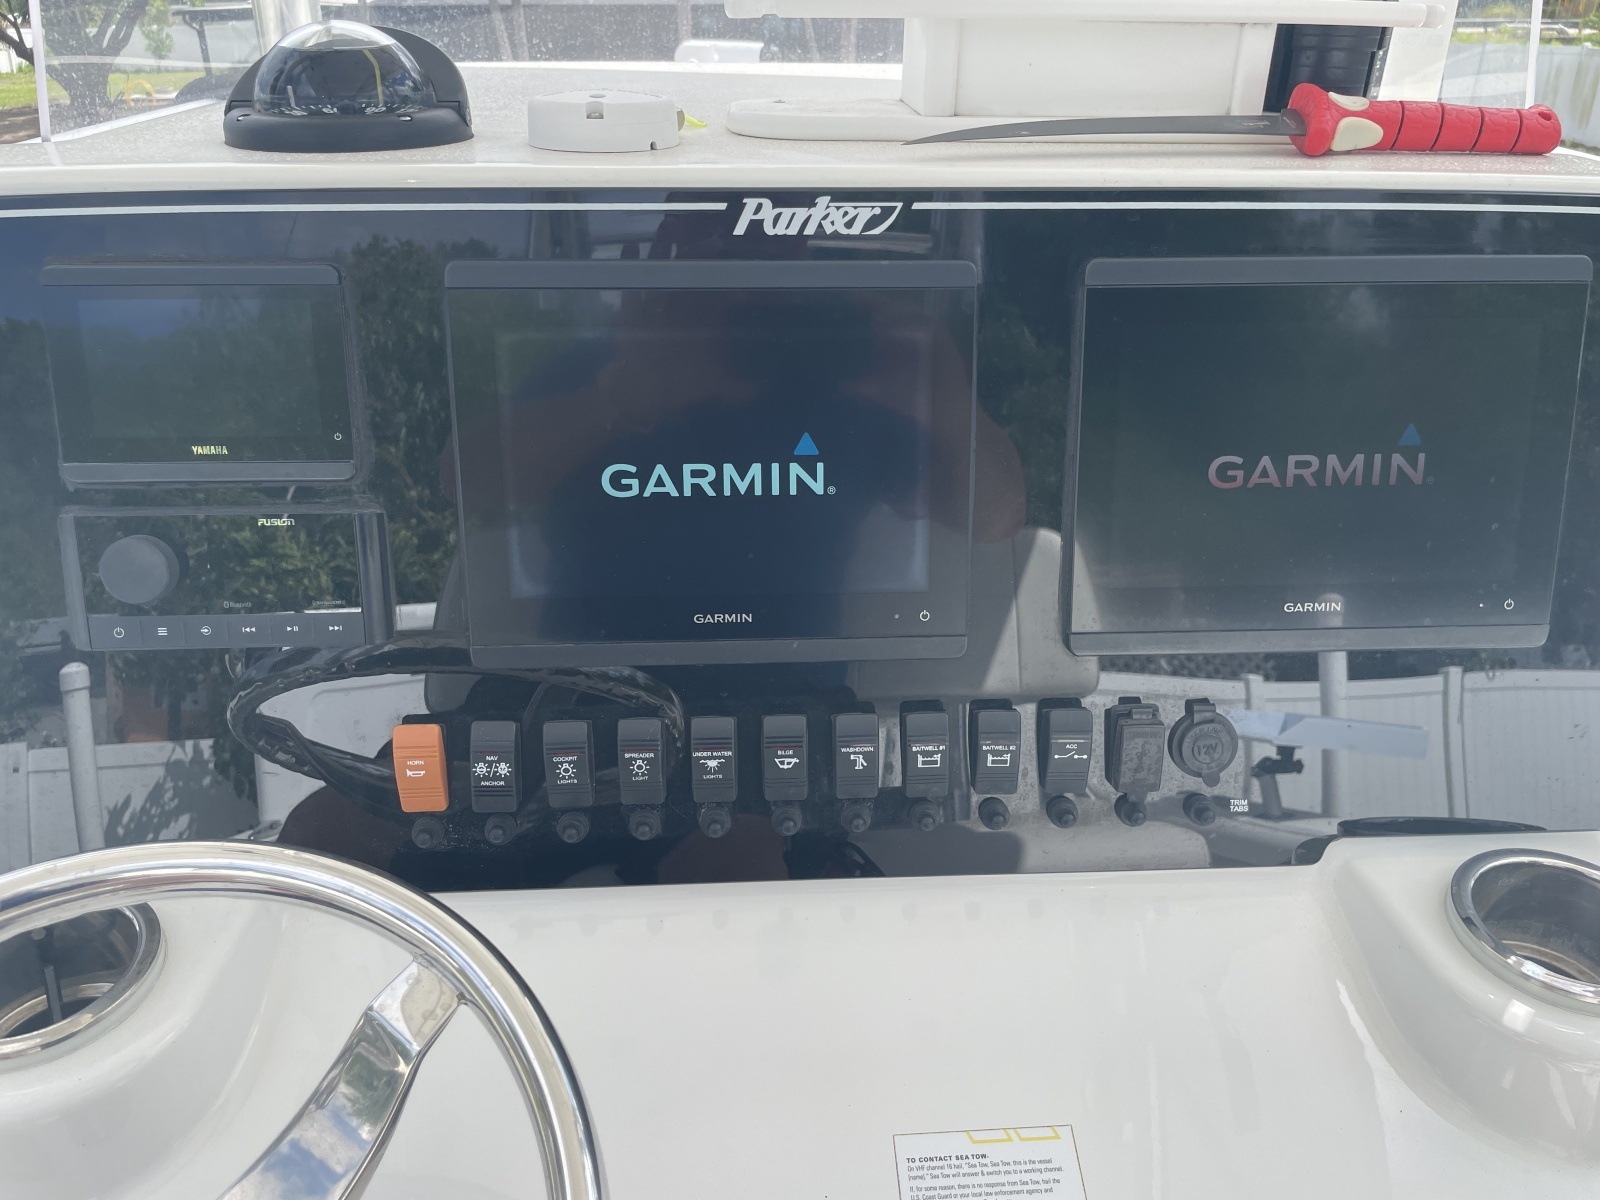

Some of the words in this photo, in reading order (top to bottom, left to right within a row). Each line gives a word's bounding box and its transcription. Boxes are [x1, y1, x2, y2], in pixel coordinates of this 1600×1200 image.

[732, 196, 884, 235] Parker
[192, 445, 228, 455] YAMAHA
[1284, 602, 1342, 612] GARMIN
[693, 613, 752, 624] GARMIN
